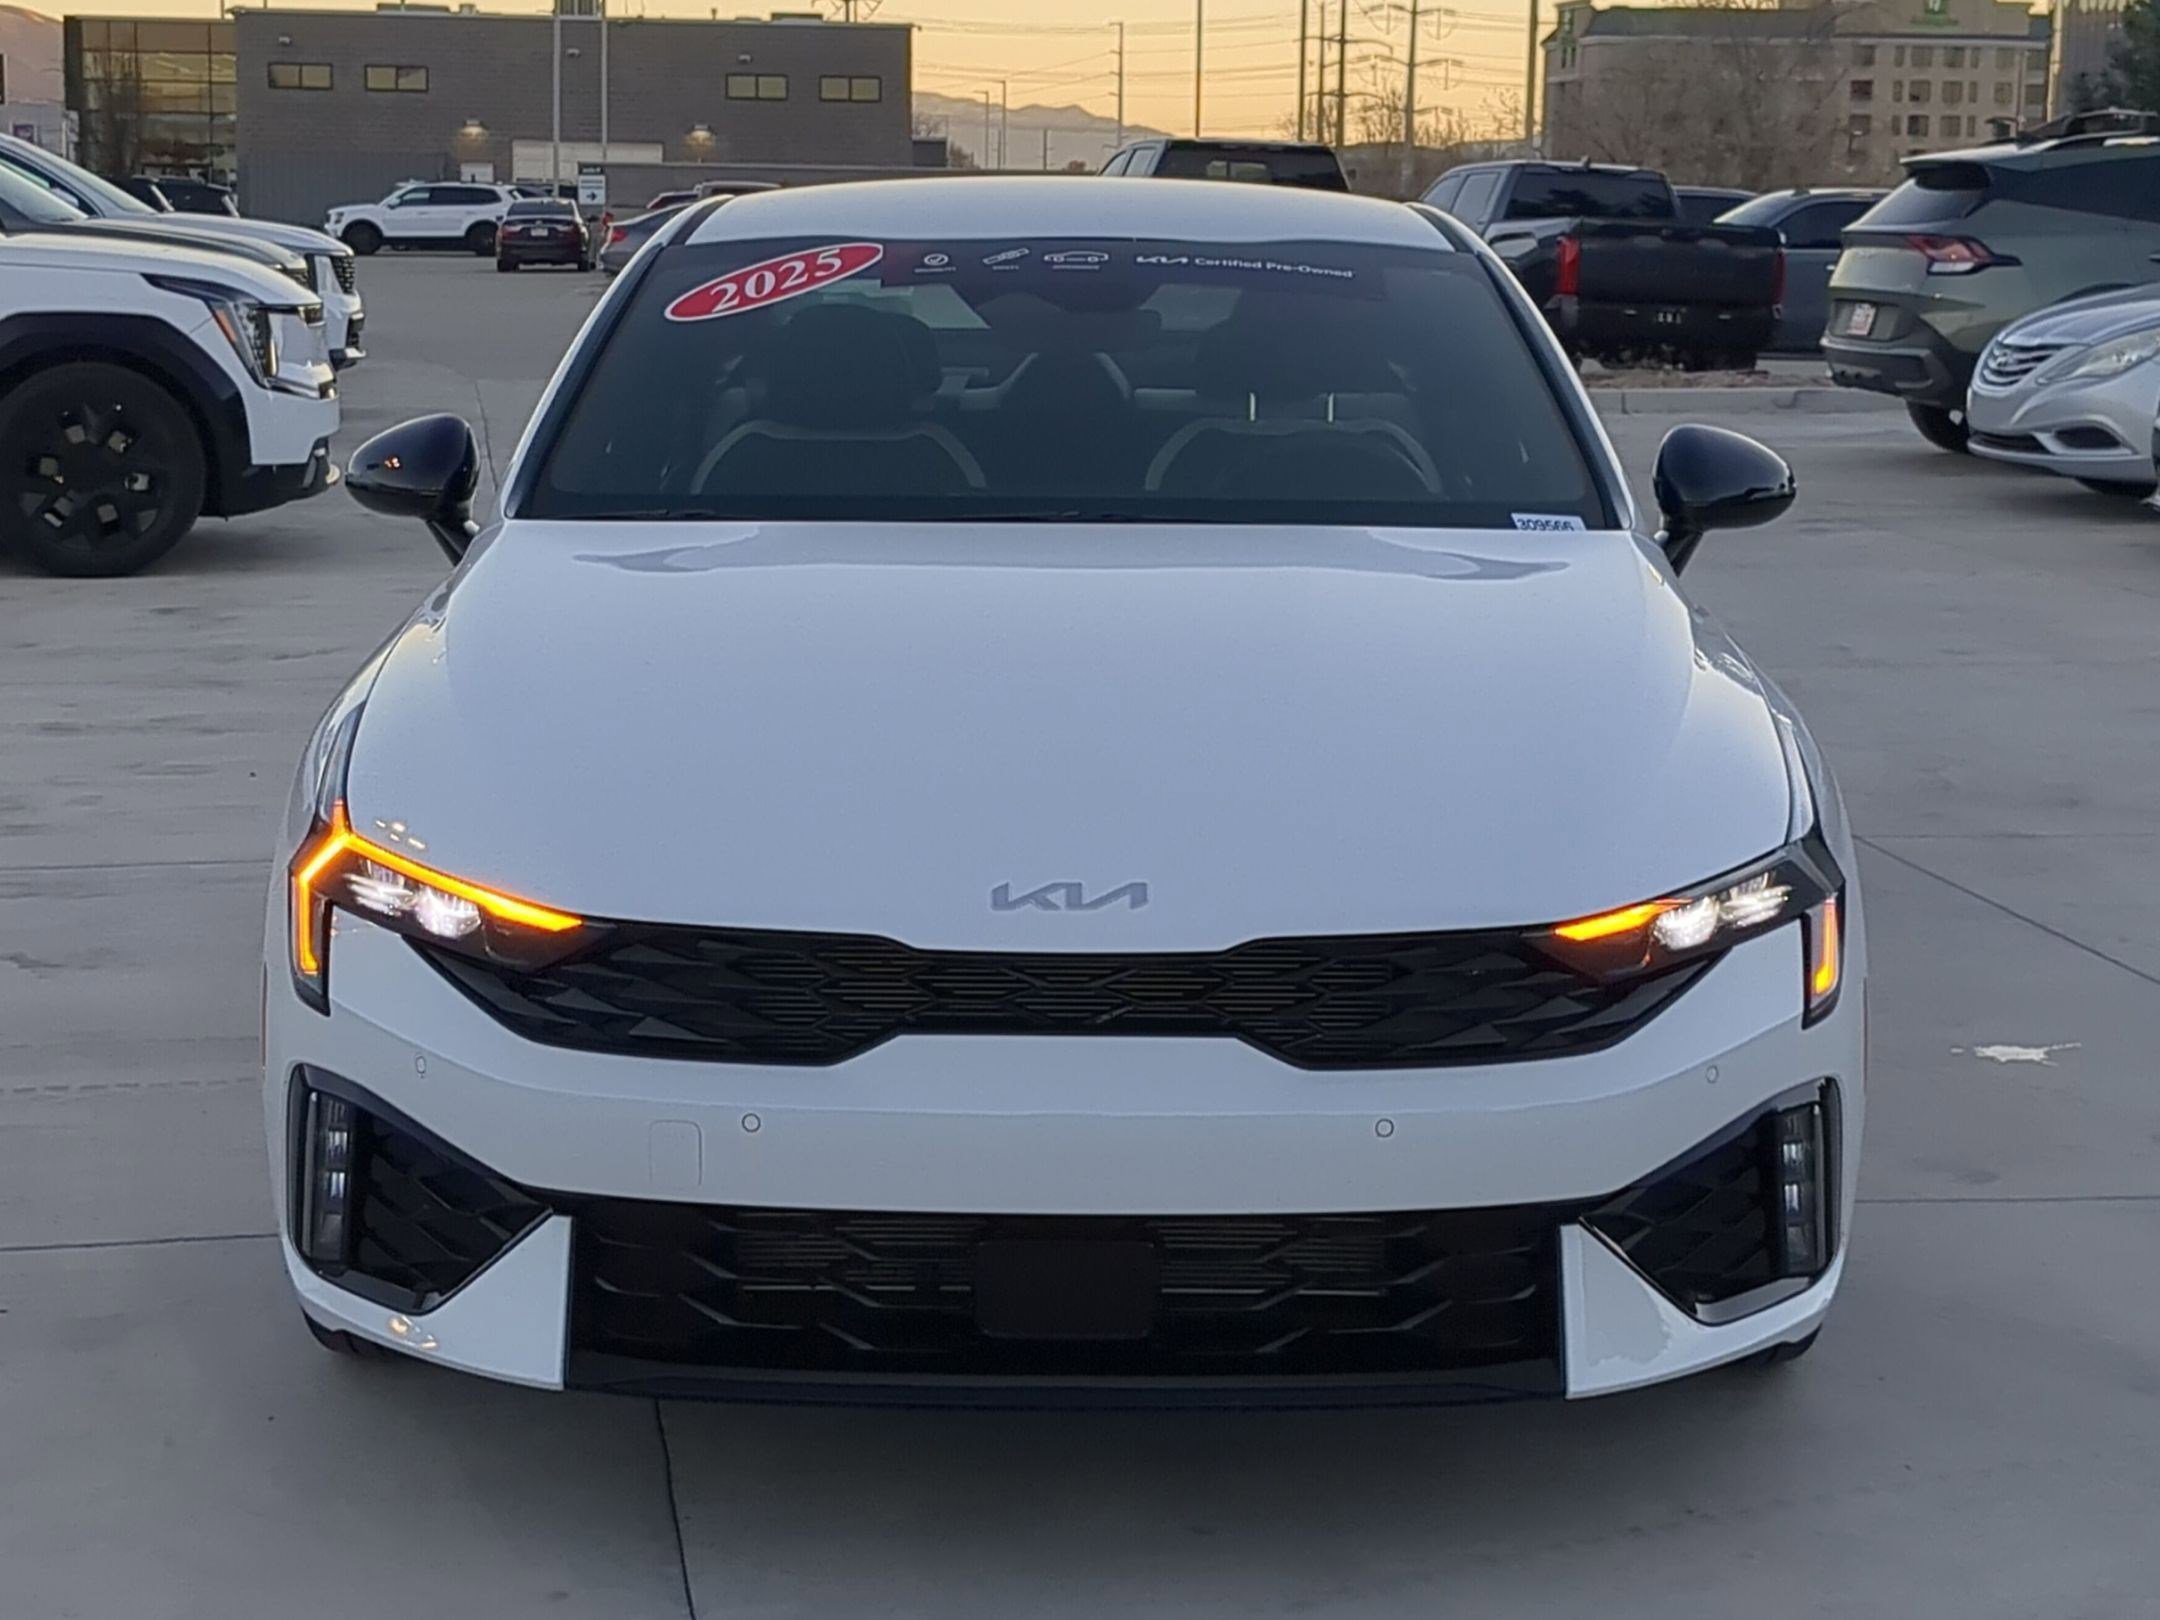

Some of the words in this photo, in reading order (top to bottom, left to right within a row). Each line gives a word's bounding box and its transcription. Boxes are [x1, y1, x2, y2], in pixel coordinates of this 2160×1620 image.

[710, 248, 843, 314] 2025
[1195, 257, 1263, 269] Certified
[1266, 261, 1354, 278] Pre-Owned
[991, 881, 1149, 911] KIA
